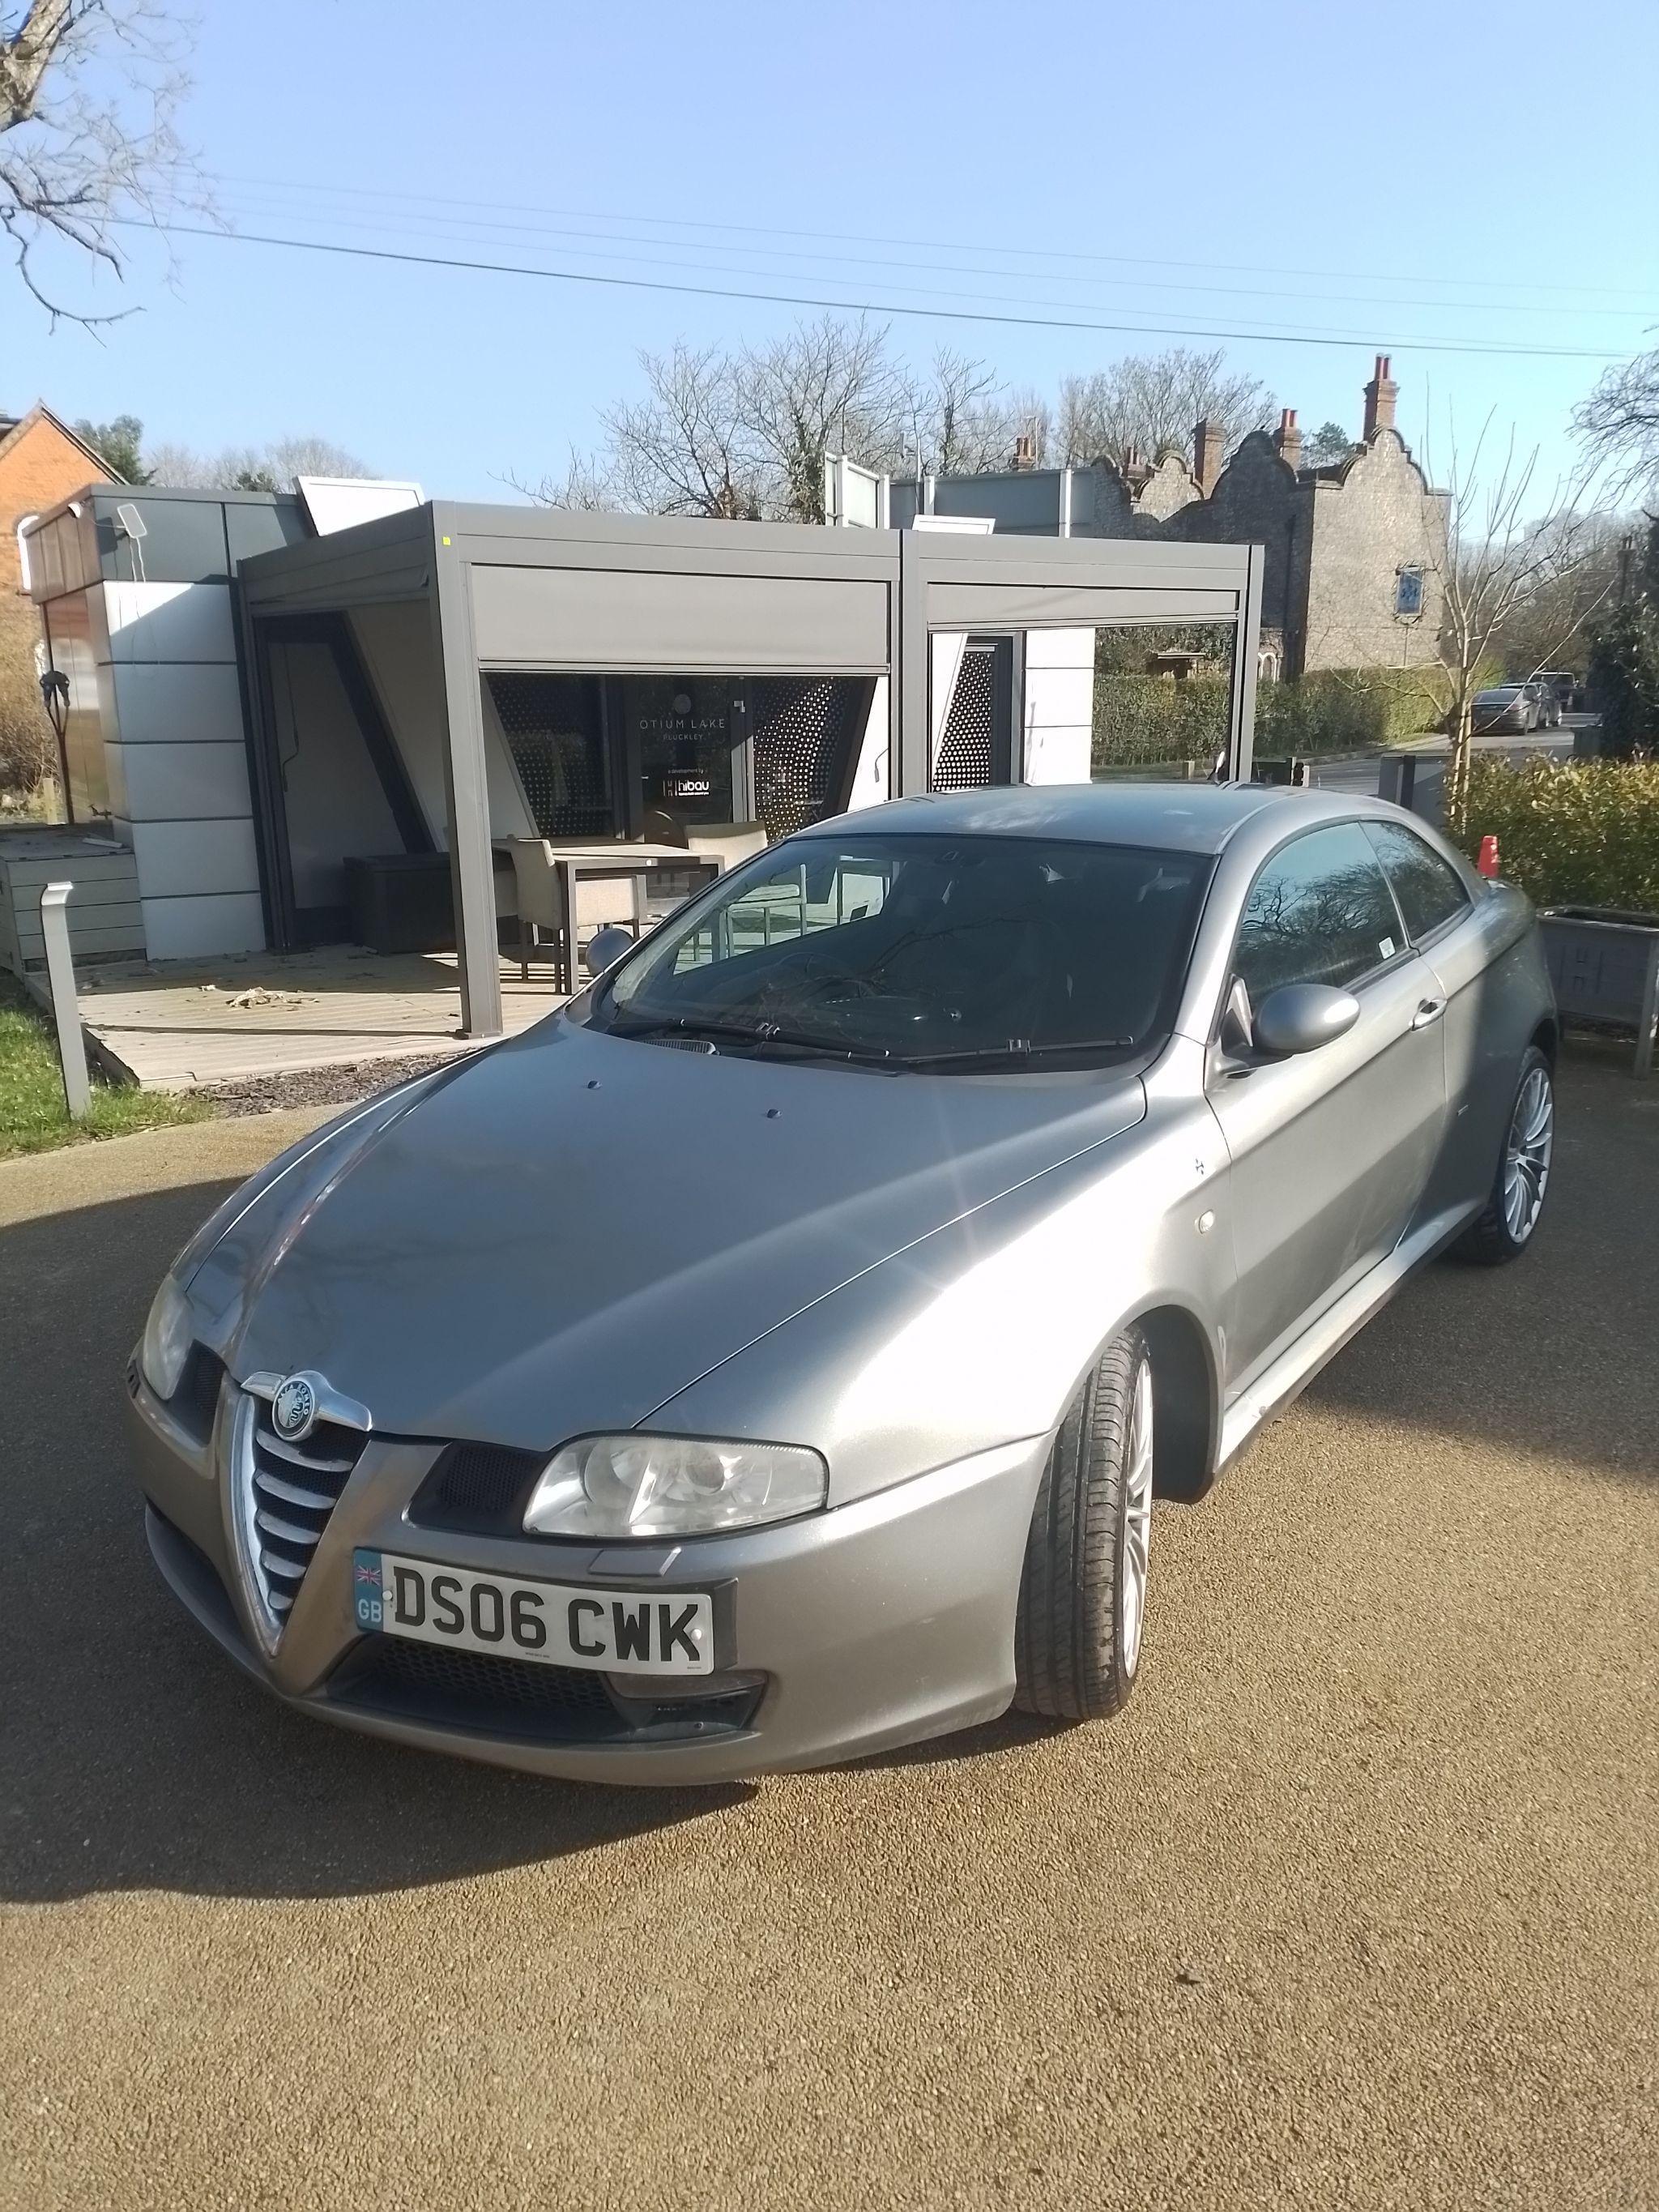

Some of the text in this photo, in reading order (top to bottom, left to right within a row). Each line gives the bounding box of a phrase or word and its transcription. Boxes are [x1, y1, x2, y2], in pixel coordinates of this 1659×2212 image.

[639, 719, 725, 729] OTIUM LAKE
[678, 779, 710, 792] hibau
[358, 1599, 382, 1622] GB
[393, 1566, 701, 1662] DS06 CWK
